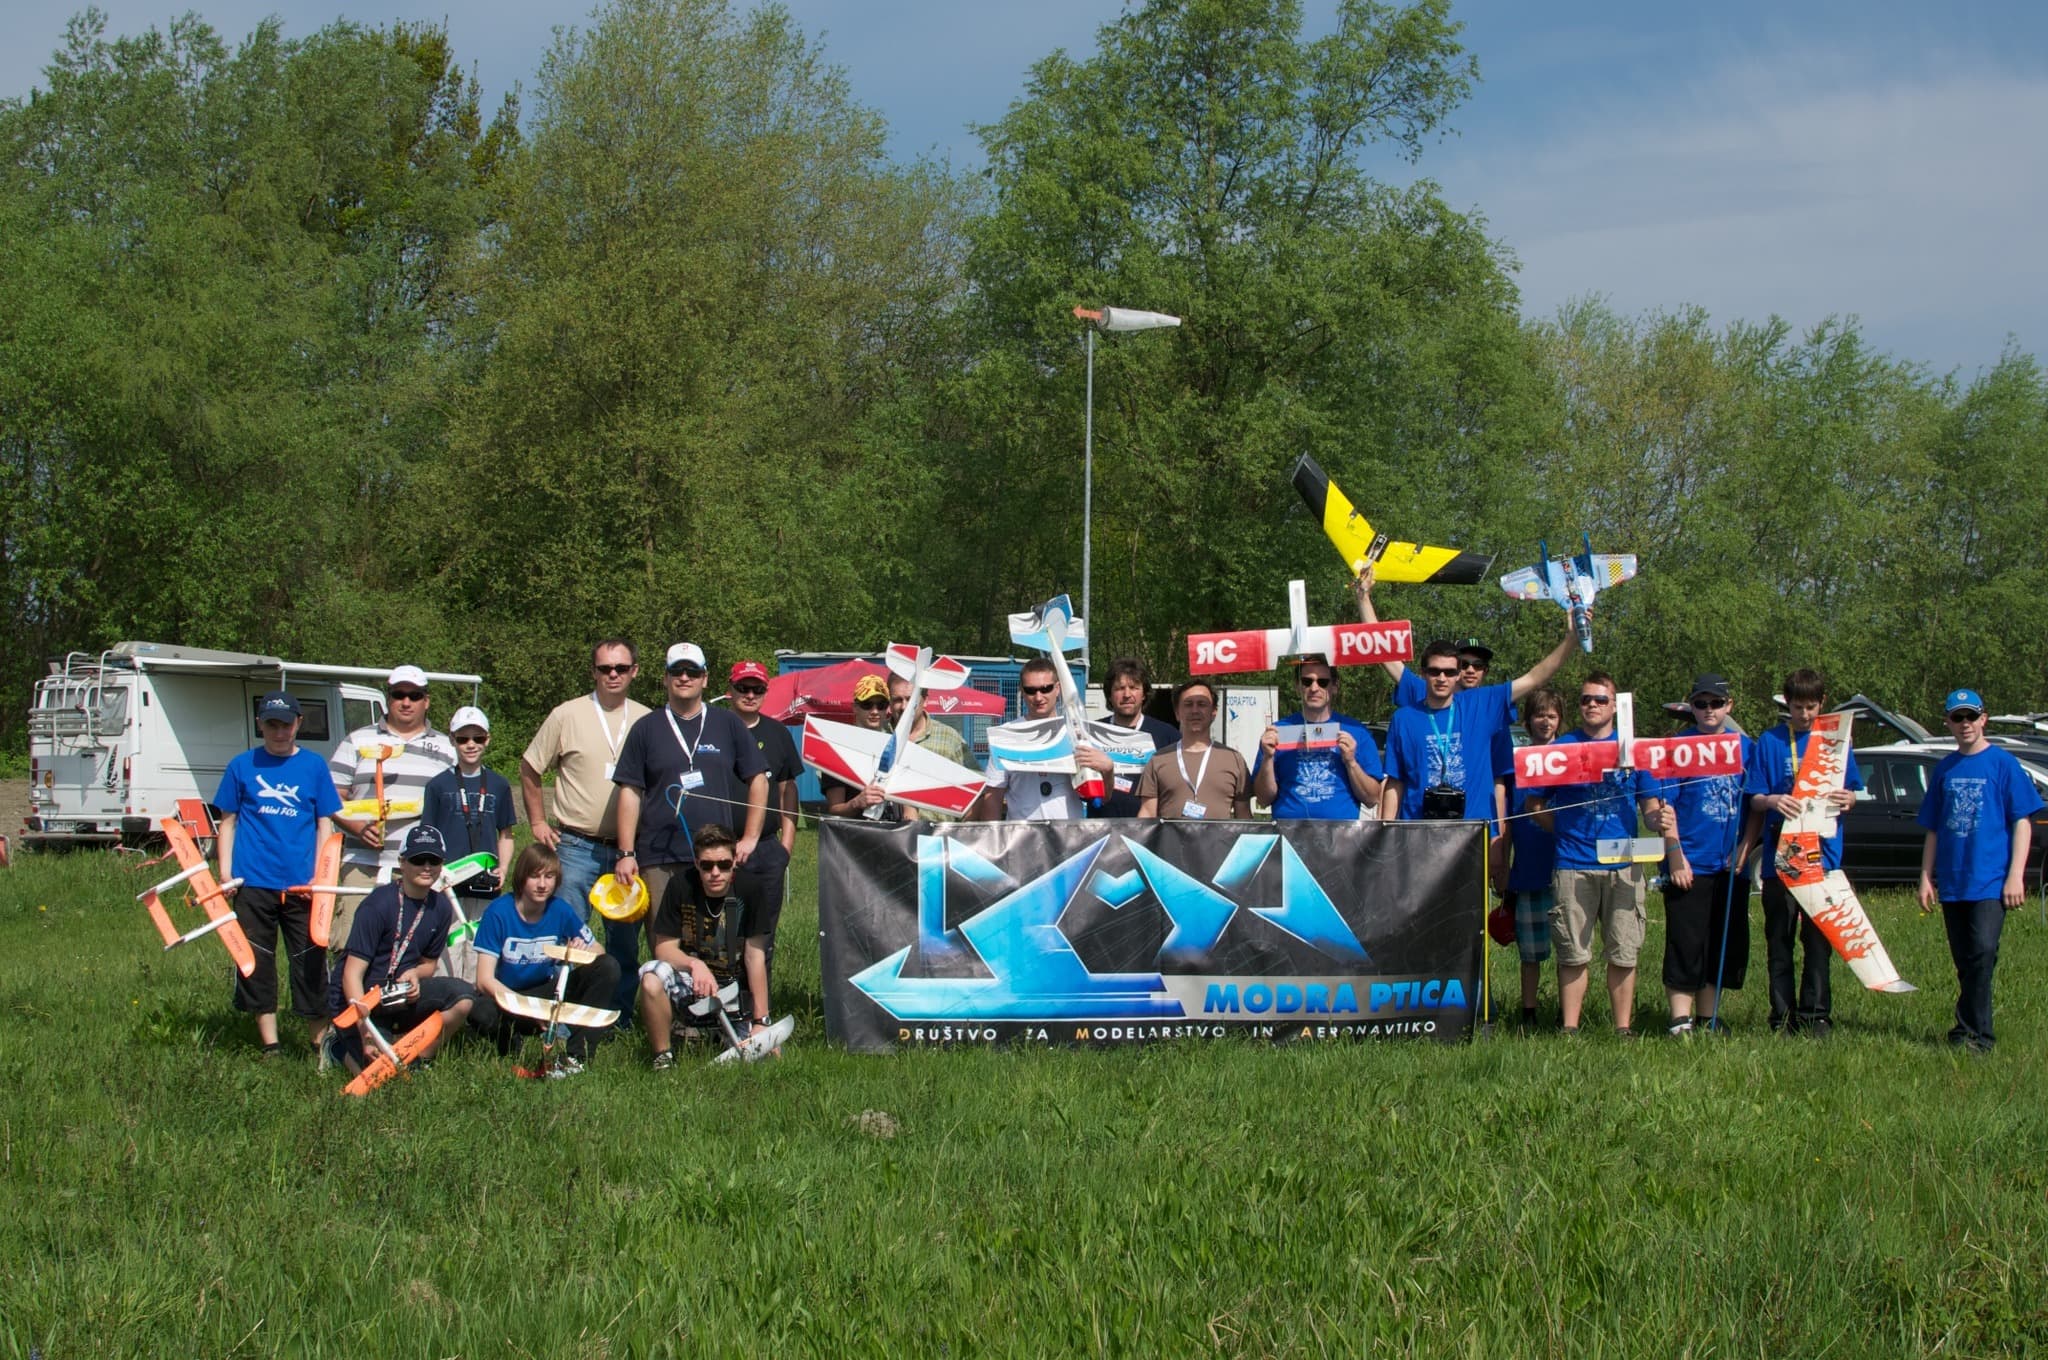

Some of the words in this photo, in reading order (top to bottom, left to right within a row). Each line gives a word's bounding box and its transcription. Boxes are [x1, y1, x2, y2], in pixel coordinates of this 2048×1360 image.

[1339, 629, 1410, 656] PONY
[1649, 740, 1740, 770] PONY
[1203, 982, 1359, 1014] MODRA
[1370, 979, 1468, 1012] PTICA
[899, 1025, 998, 1041] DRUŠTVO
[1024, 1028, 1048, 1040] ZA
[1075, 1025, 1225, 1040] MODELARSTVO
[1253, 1026, 1273, 1038] IN
